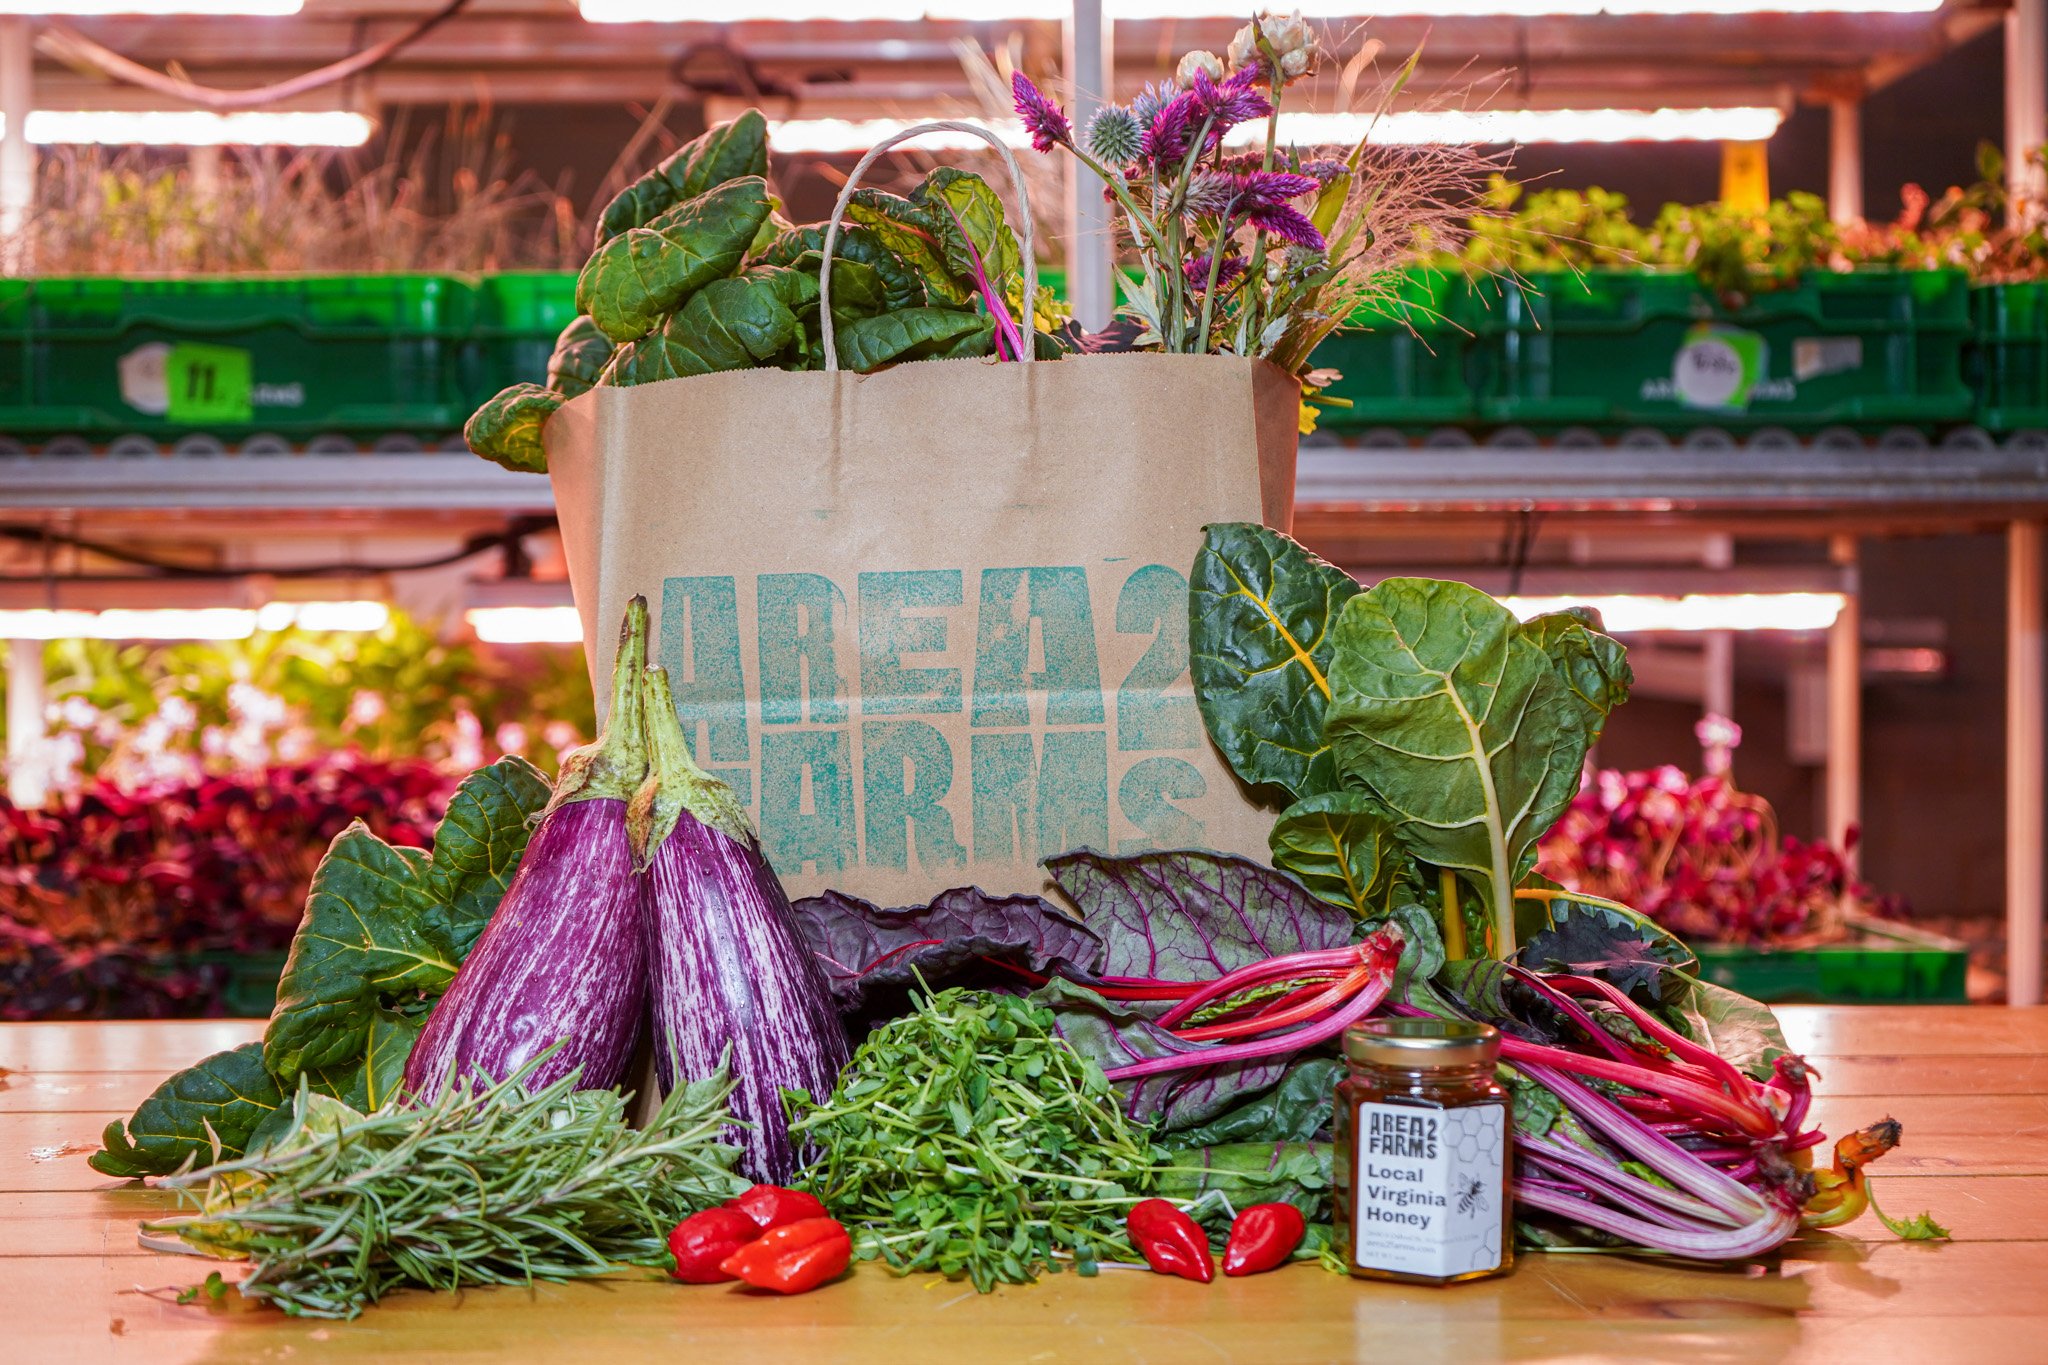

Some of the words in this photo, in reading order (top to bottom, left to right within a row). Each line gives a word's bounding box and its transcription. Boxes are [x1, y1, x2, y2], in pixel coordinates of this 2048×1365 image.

[658, 563, 1201, 762] AREA2
[1370, 1112, 1438, 1141] AREA2
[1369, 1134, 1437, 1159] FARMS
[1368, 1163, 1423, 1182] Local
[1367, 1185, 1447, 1207] Virginia
[1367, 1206, 1431, 1230] Honey
